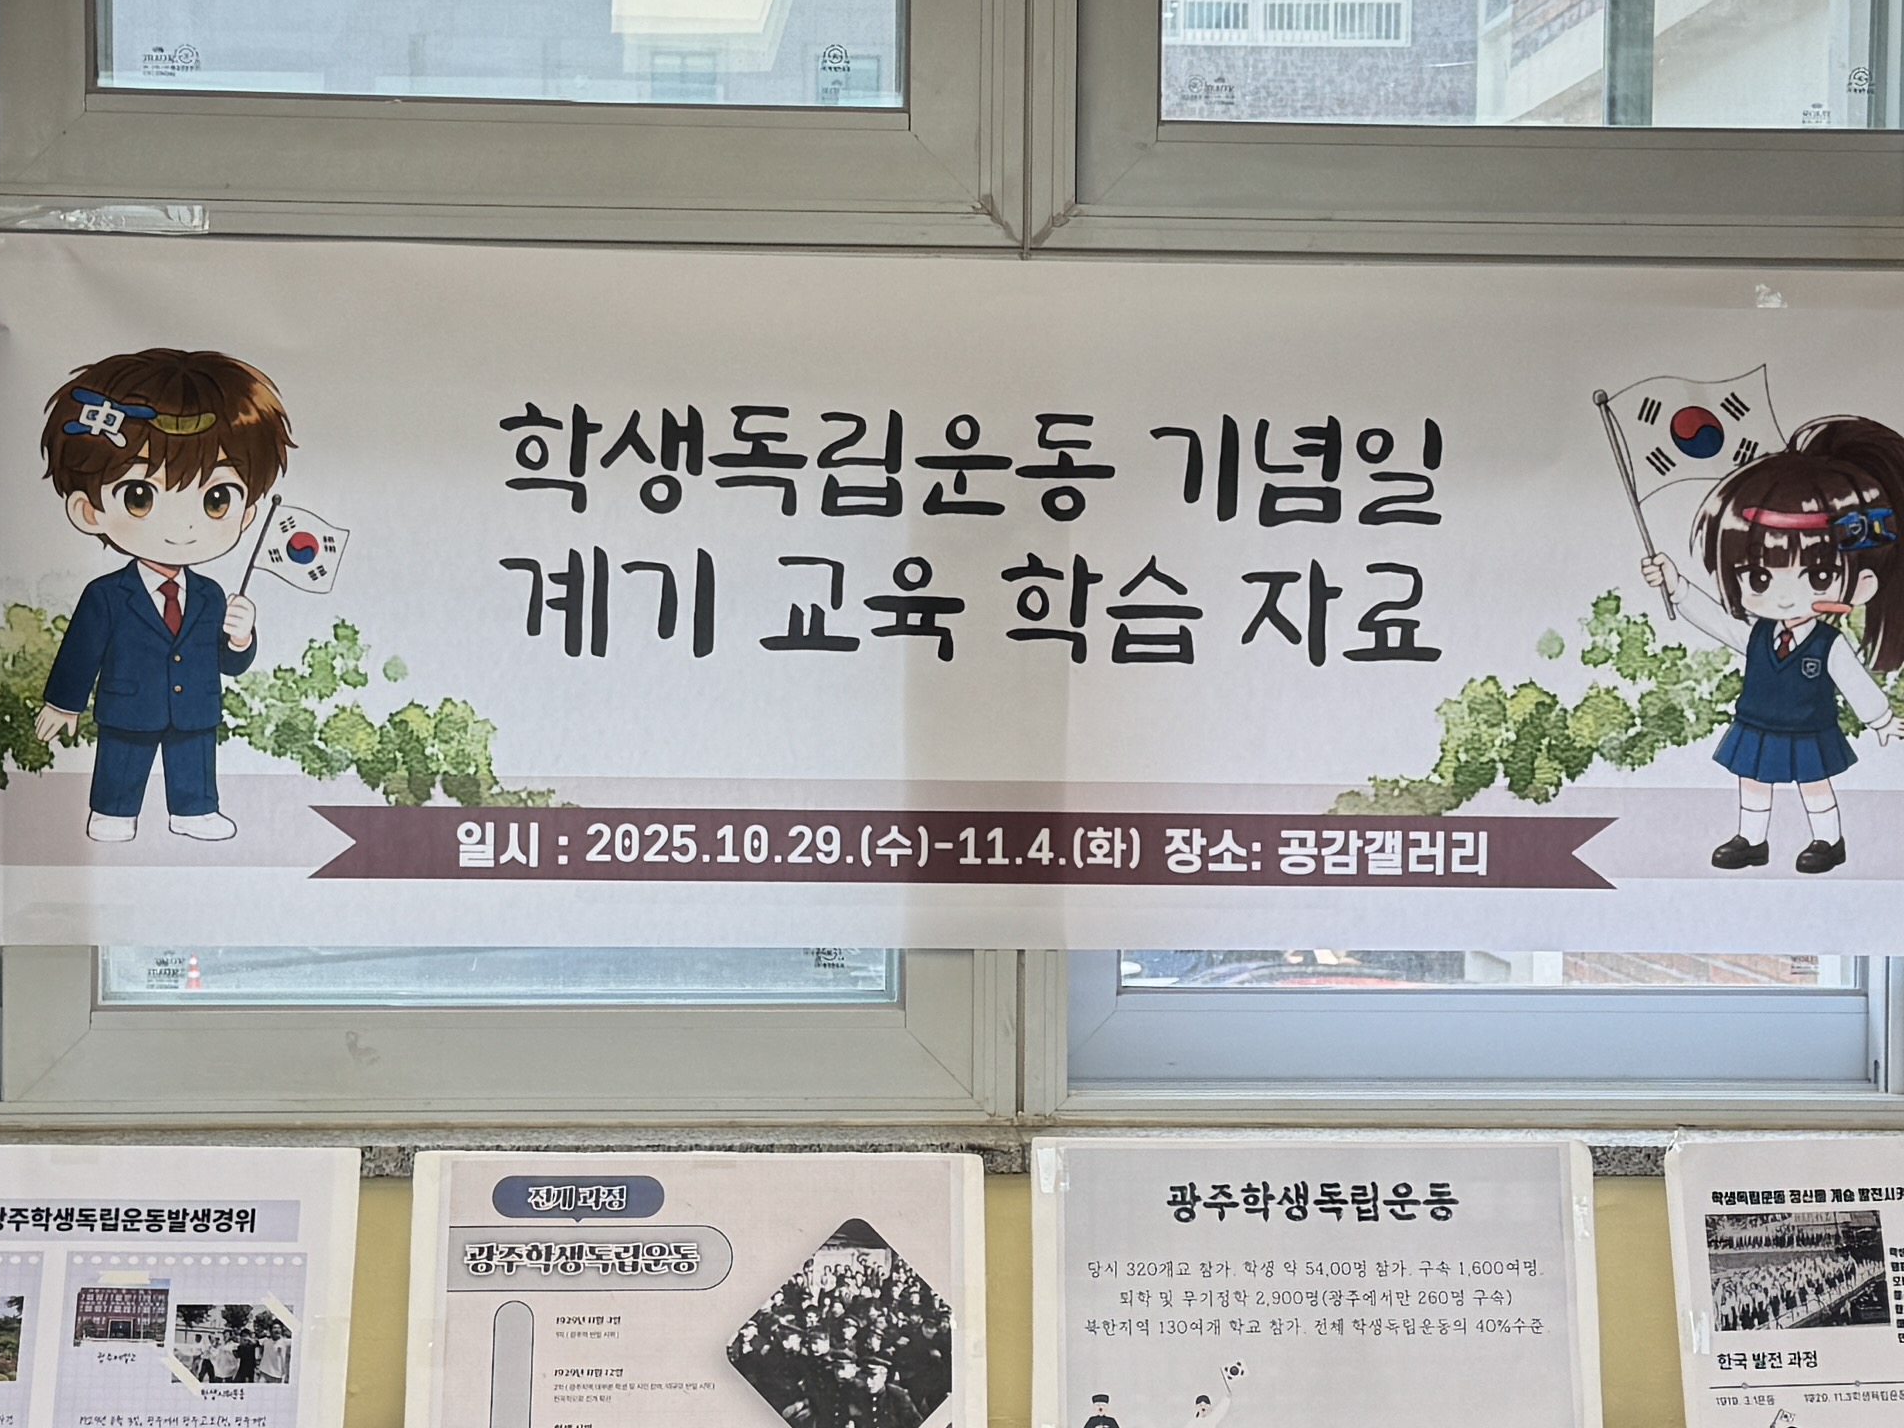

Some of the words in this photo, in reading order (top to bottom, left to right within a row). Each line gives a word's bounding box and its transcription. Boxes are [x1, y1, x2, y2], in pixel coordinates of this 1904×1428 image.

[499, 401, 1116, 521] 학생독립운동
[1149, 412, 1443, 527] 기념일
[499, 545, 714, 659] 계기
[759, 556, 965, 662] 교육
[1001, 552, 1204, 666] 학습
[1241, 559, 1443, 667] 자료
[455, 820, 540, 869] 일시
[584, 822, 1141, 869] 2025.10.29.(수)-11.4.(화)
[1164, 828, 1263, 874] 장소:
[1278, 828, 1490, 877] 공감갤러리
[578, 1185, 627, 1211] 과정
[1167, 1181, 1459, 1222] 광주학생독립운동
[464, 1242, 700, 1276] 광주학생독립운동
[1088, 1261, 1118, 1278] 당시
[1126, 1261, 1192, 1278] 320개교
[1244, 1261, 1275, 1278] 학생
[1283, 1261, 1297, 1278] 약
[1418, 1260, 1452, 1277] 구속
[1119, 1290, 1152, 1307] 퇴학
[1159, 1290, 1173, 1307] 및
[1182, 1290, 1250, 1307] 무기정학
[1418, 1290, 1464, 1306] 260명
[1472, 1290, 1512, 1306] 구속)
[1084, 1319, 1149, 1336] 북한지역
[1159, 1319, 1221, 1336] 130여개
[1229, 1319, 1261, 1336] 학교
[1314, 1319, 1344, 1336] 전체
[1352, 1318, 1467, 1335] 학생독립운동의
[1717, 1353, 1748, 1370] 한국
[1751, 1352, 1783, 1369] 발전
[1787, 1350, 1818, 1368] 과정
